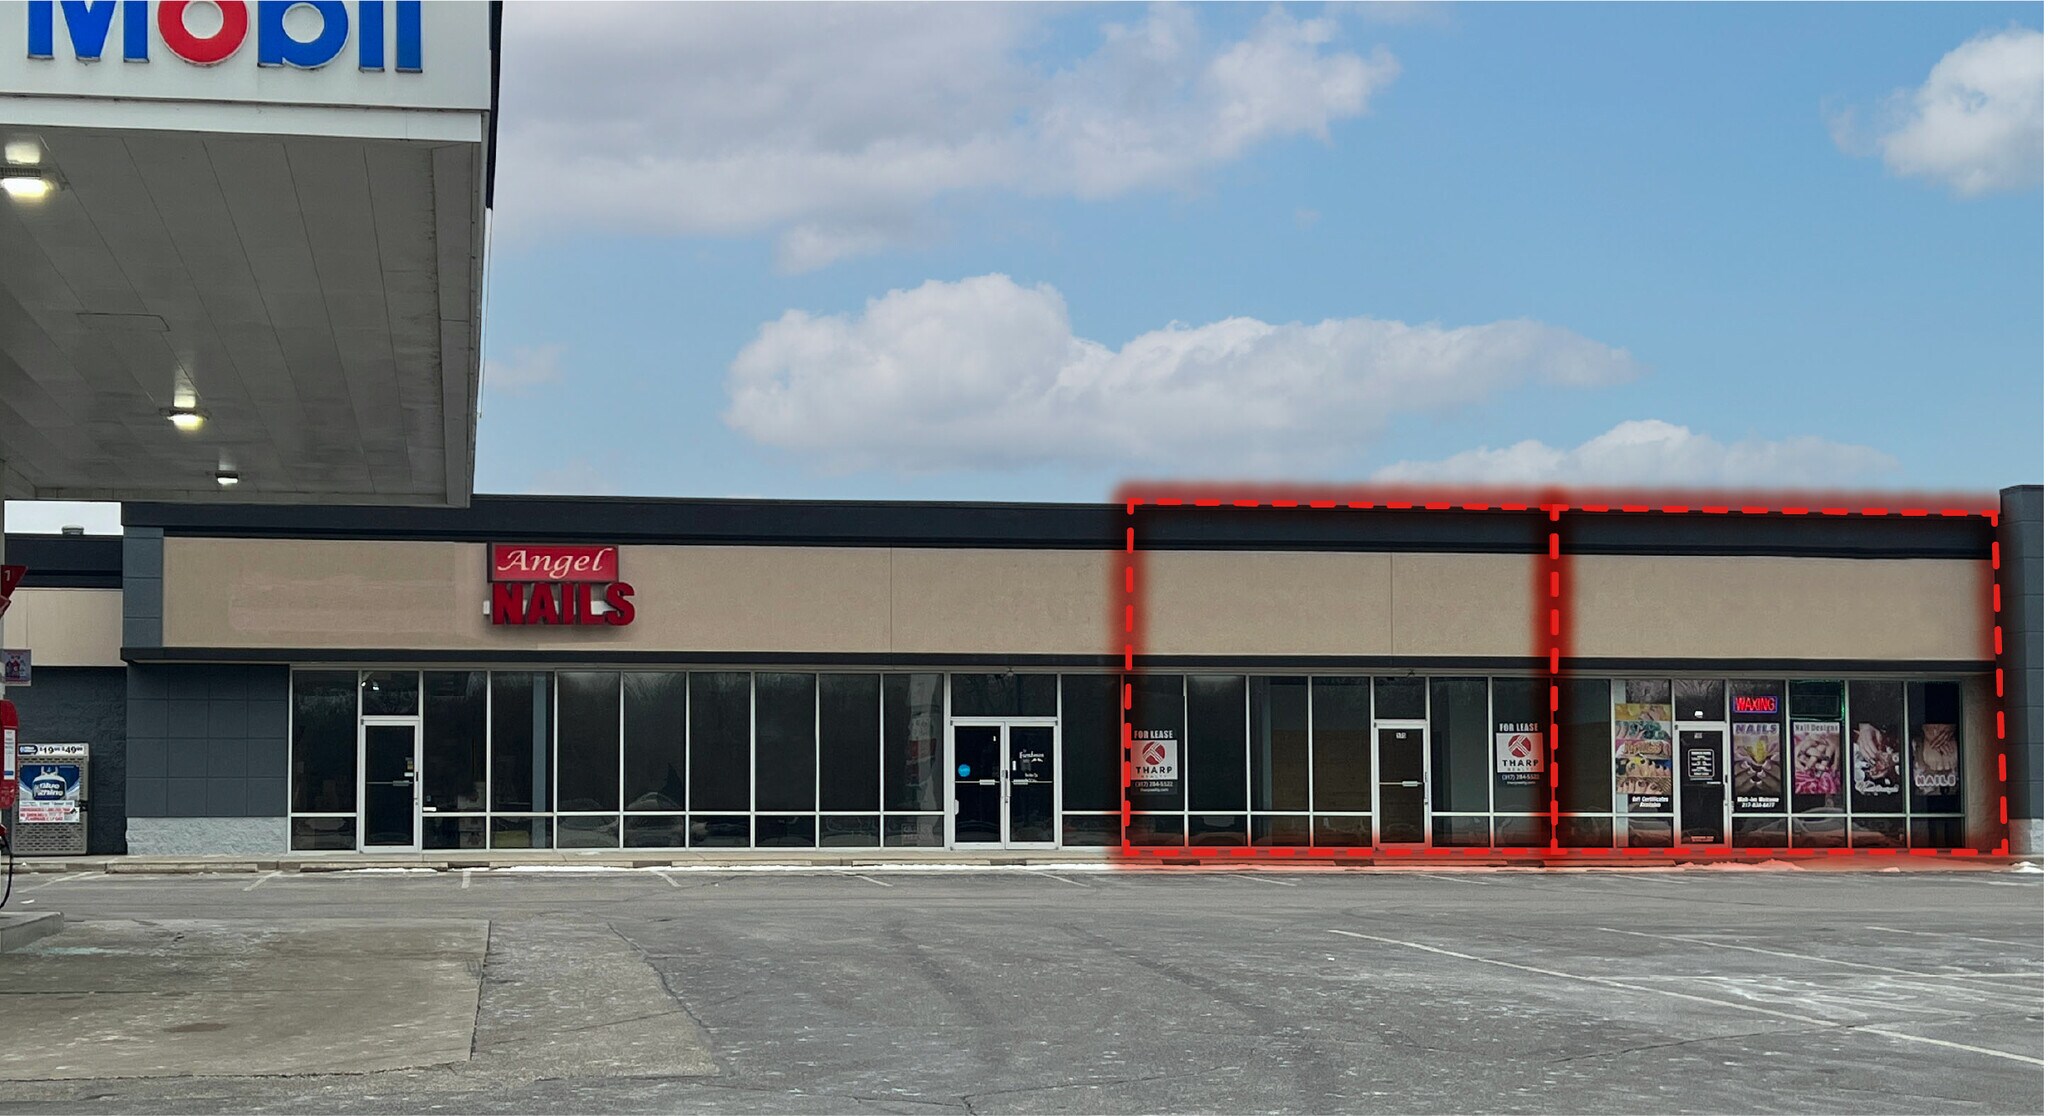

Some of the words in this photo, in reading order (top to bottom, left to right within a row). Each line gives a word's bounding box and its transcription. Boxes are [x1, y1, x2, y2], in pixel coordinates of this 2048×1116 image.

[497, 547, 613, 579] Angel
[4, 570, 11, 582] 1
[492, 582, 635, 625] NAILS
[1735, 696, 1775, 711] WAXING
[1499, 722, 1514, 731] FOR
[1516, 722, 1538, 731] LEASE
[1735, 724, 1777, 734] NAILS
[1134, 730, 1149, 739] FOR
[1150, 730, 1173, 739] LEASE
[1502, 759, 1539, 767] THARP
[1135, 766, 1173, 774] THARP
[1916, 775, 1956, 786] NAILS
